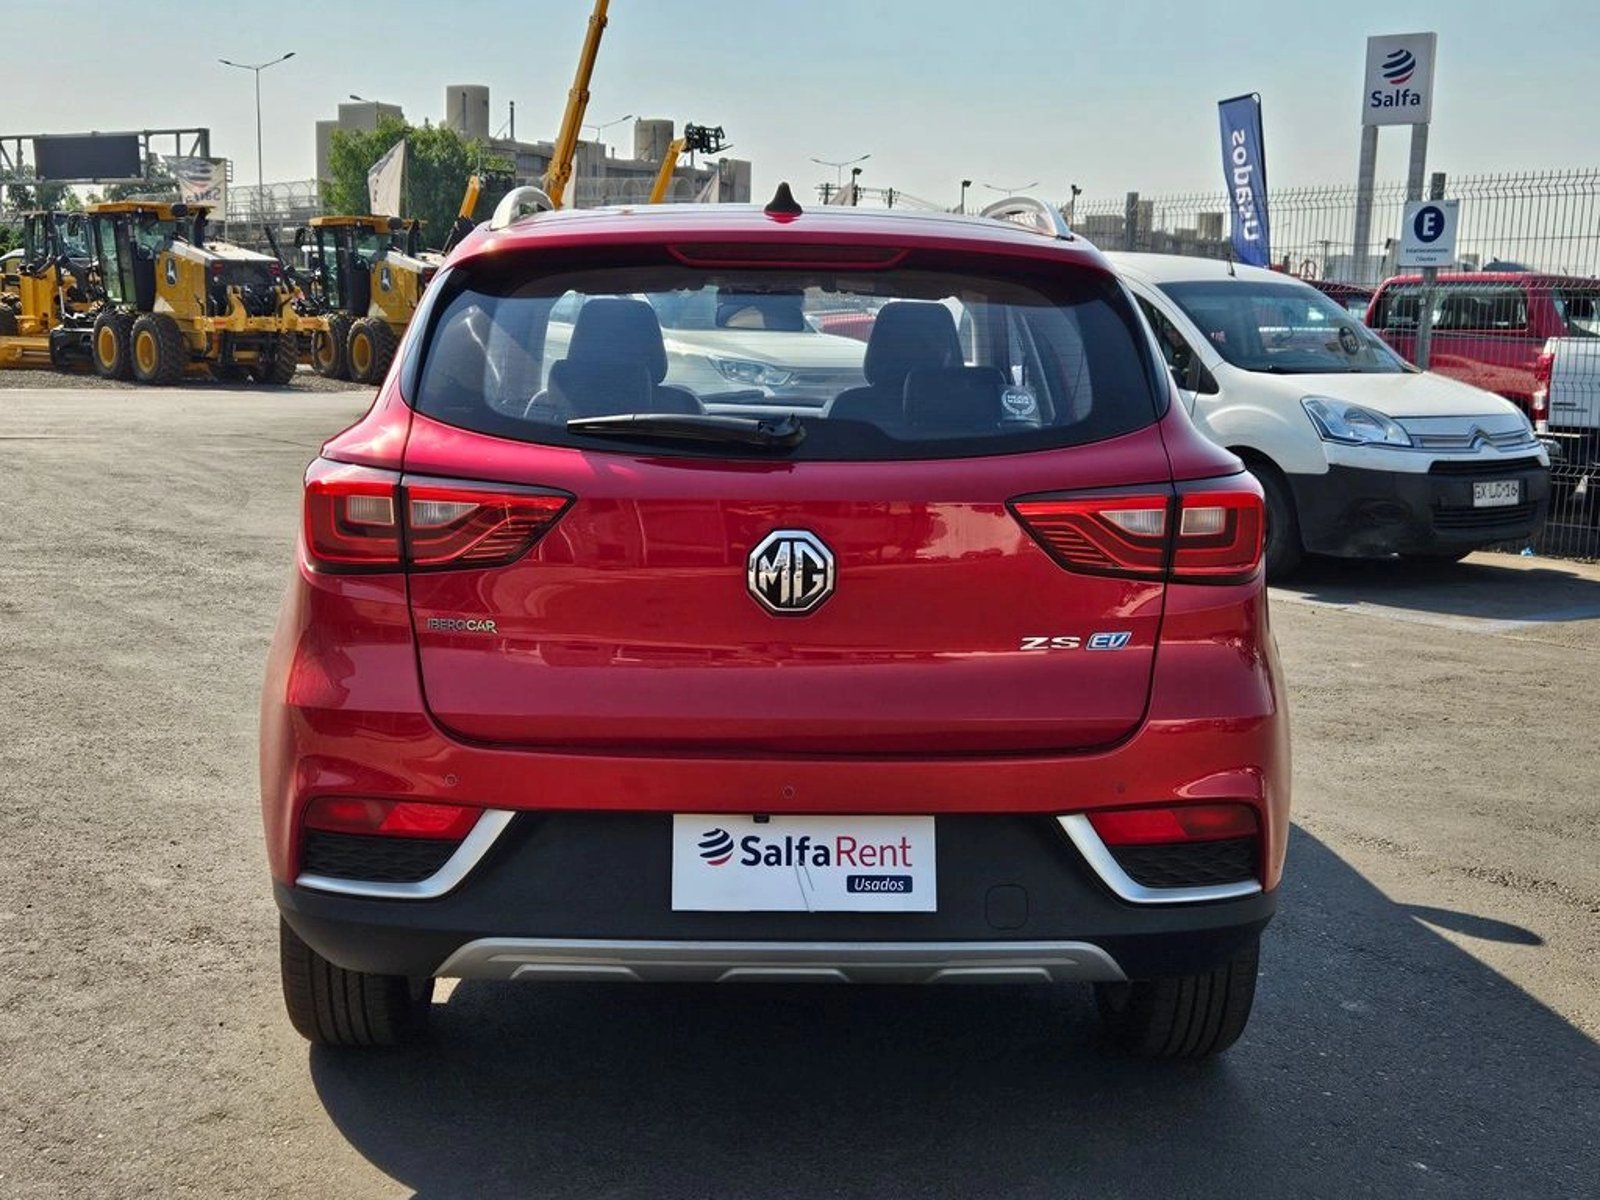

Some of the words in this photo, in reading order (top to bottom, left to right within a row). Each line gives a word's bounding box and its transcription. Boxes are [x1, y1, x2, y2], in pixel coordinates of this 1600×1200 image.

[1371, 89, 1421, 108] Salfa
[1422, 213, 1436, 237] E
[758, 541, 825, 606] MG
[427, 618, 498, 634] IBEROCAR
[1020, 636, 1081, 651] ZS
[1090, 633, 1127, 649] EV
[854, 877, 904, 891] Usados
